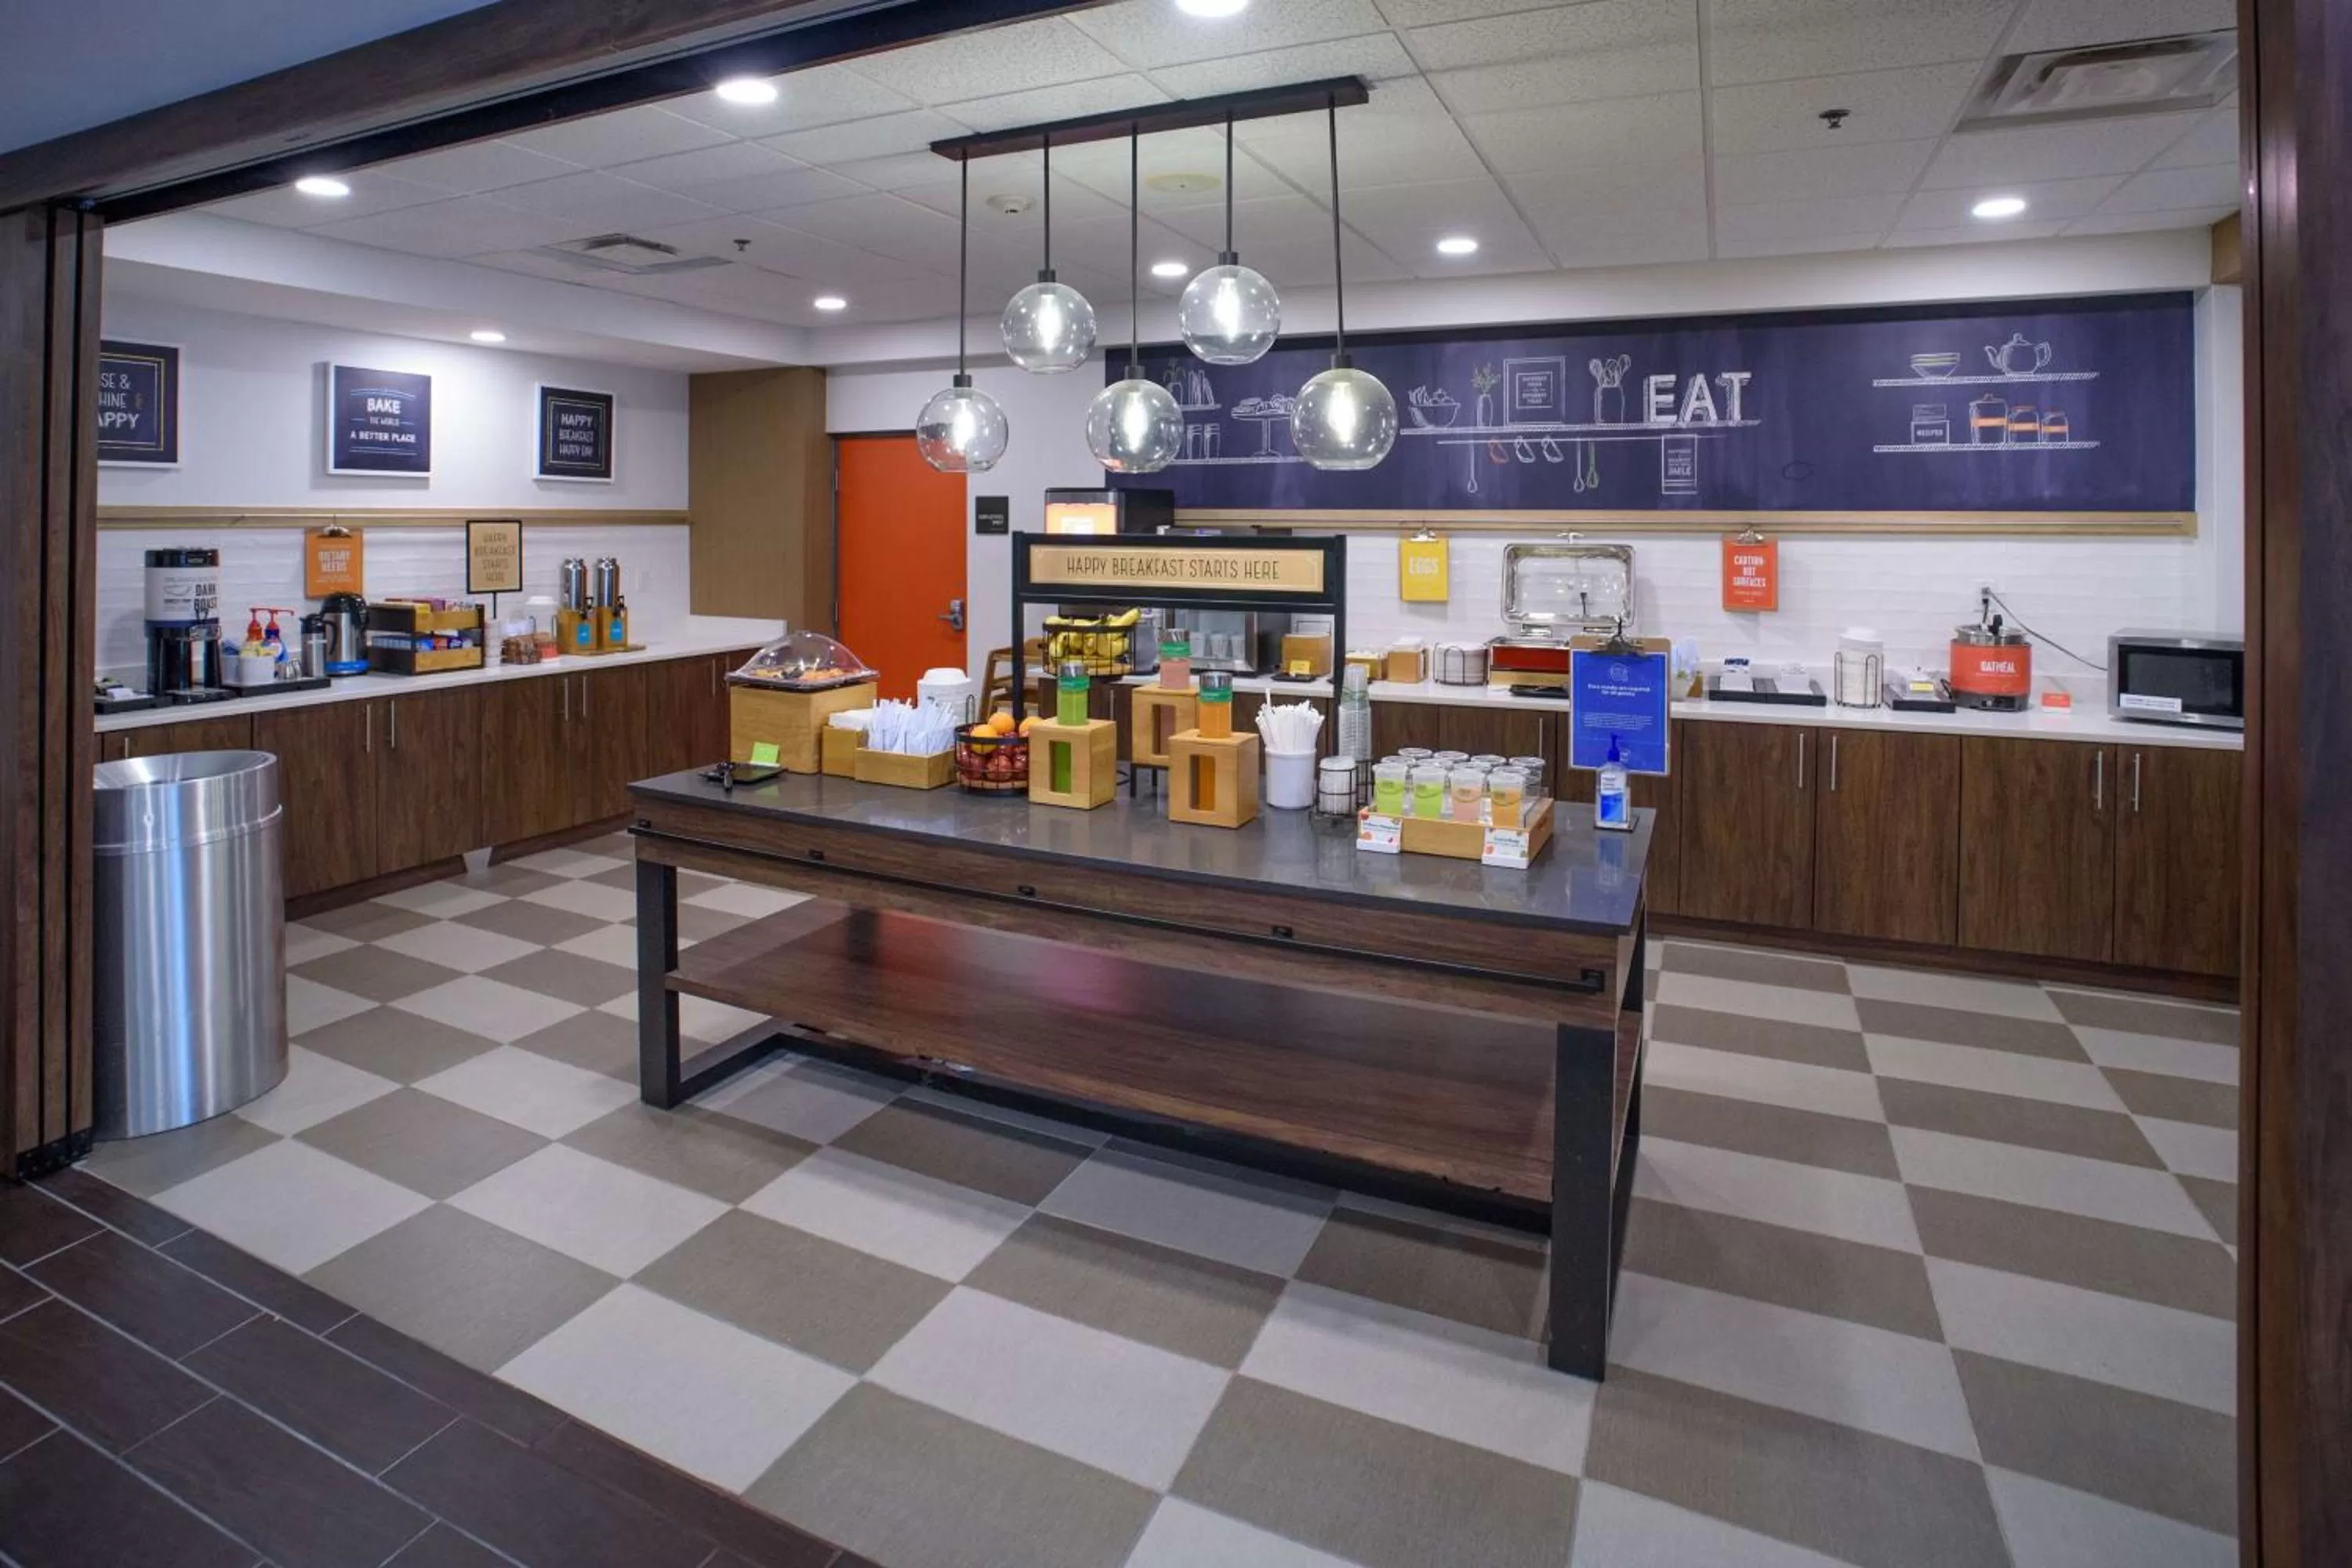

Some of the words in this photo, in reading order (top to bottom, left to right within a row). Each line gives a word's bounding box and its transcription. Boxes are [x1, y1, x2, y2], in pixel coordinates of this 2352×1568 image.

[100, 372, 115, 388] SE
[119, 373, 131, 389] &
[98, 391, 126, 408] HINE
[366, 397, 401, 415] BAKE
[1643, 371, 1751, 427] EAT
[98, 412, 140, 429] APPY
[561, 413, 593, 427] HAPPY
[358, 430, 390, 441] BETTER
[391, 432, 416, 444] PLACE
[1067, 555, 1106, 575] HAPPY
[1112, 557, 1184, 577] BREAKFAST
[1189, 558, 1239, 578] STARTS
[1243, 560, 1279, 580] HERE
[1980, 661, 2016, 673] OATMEAL
